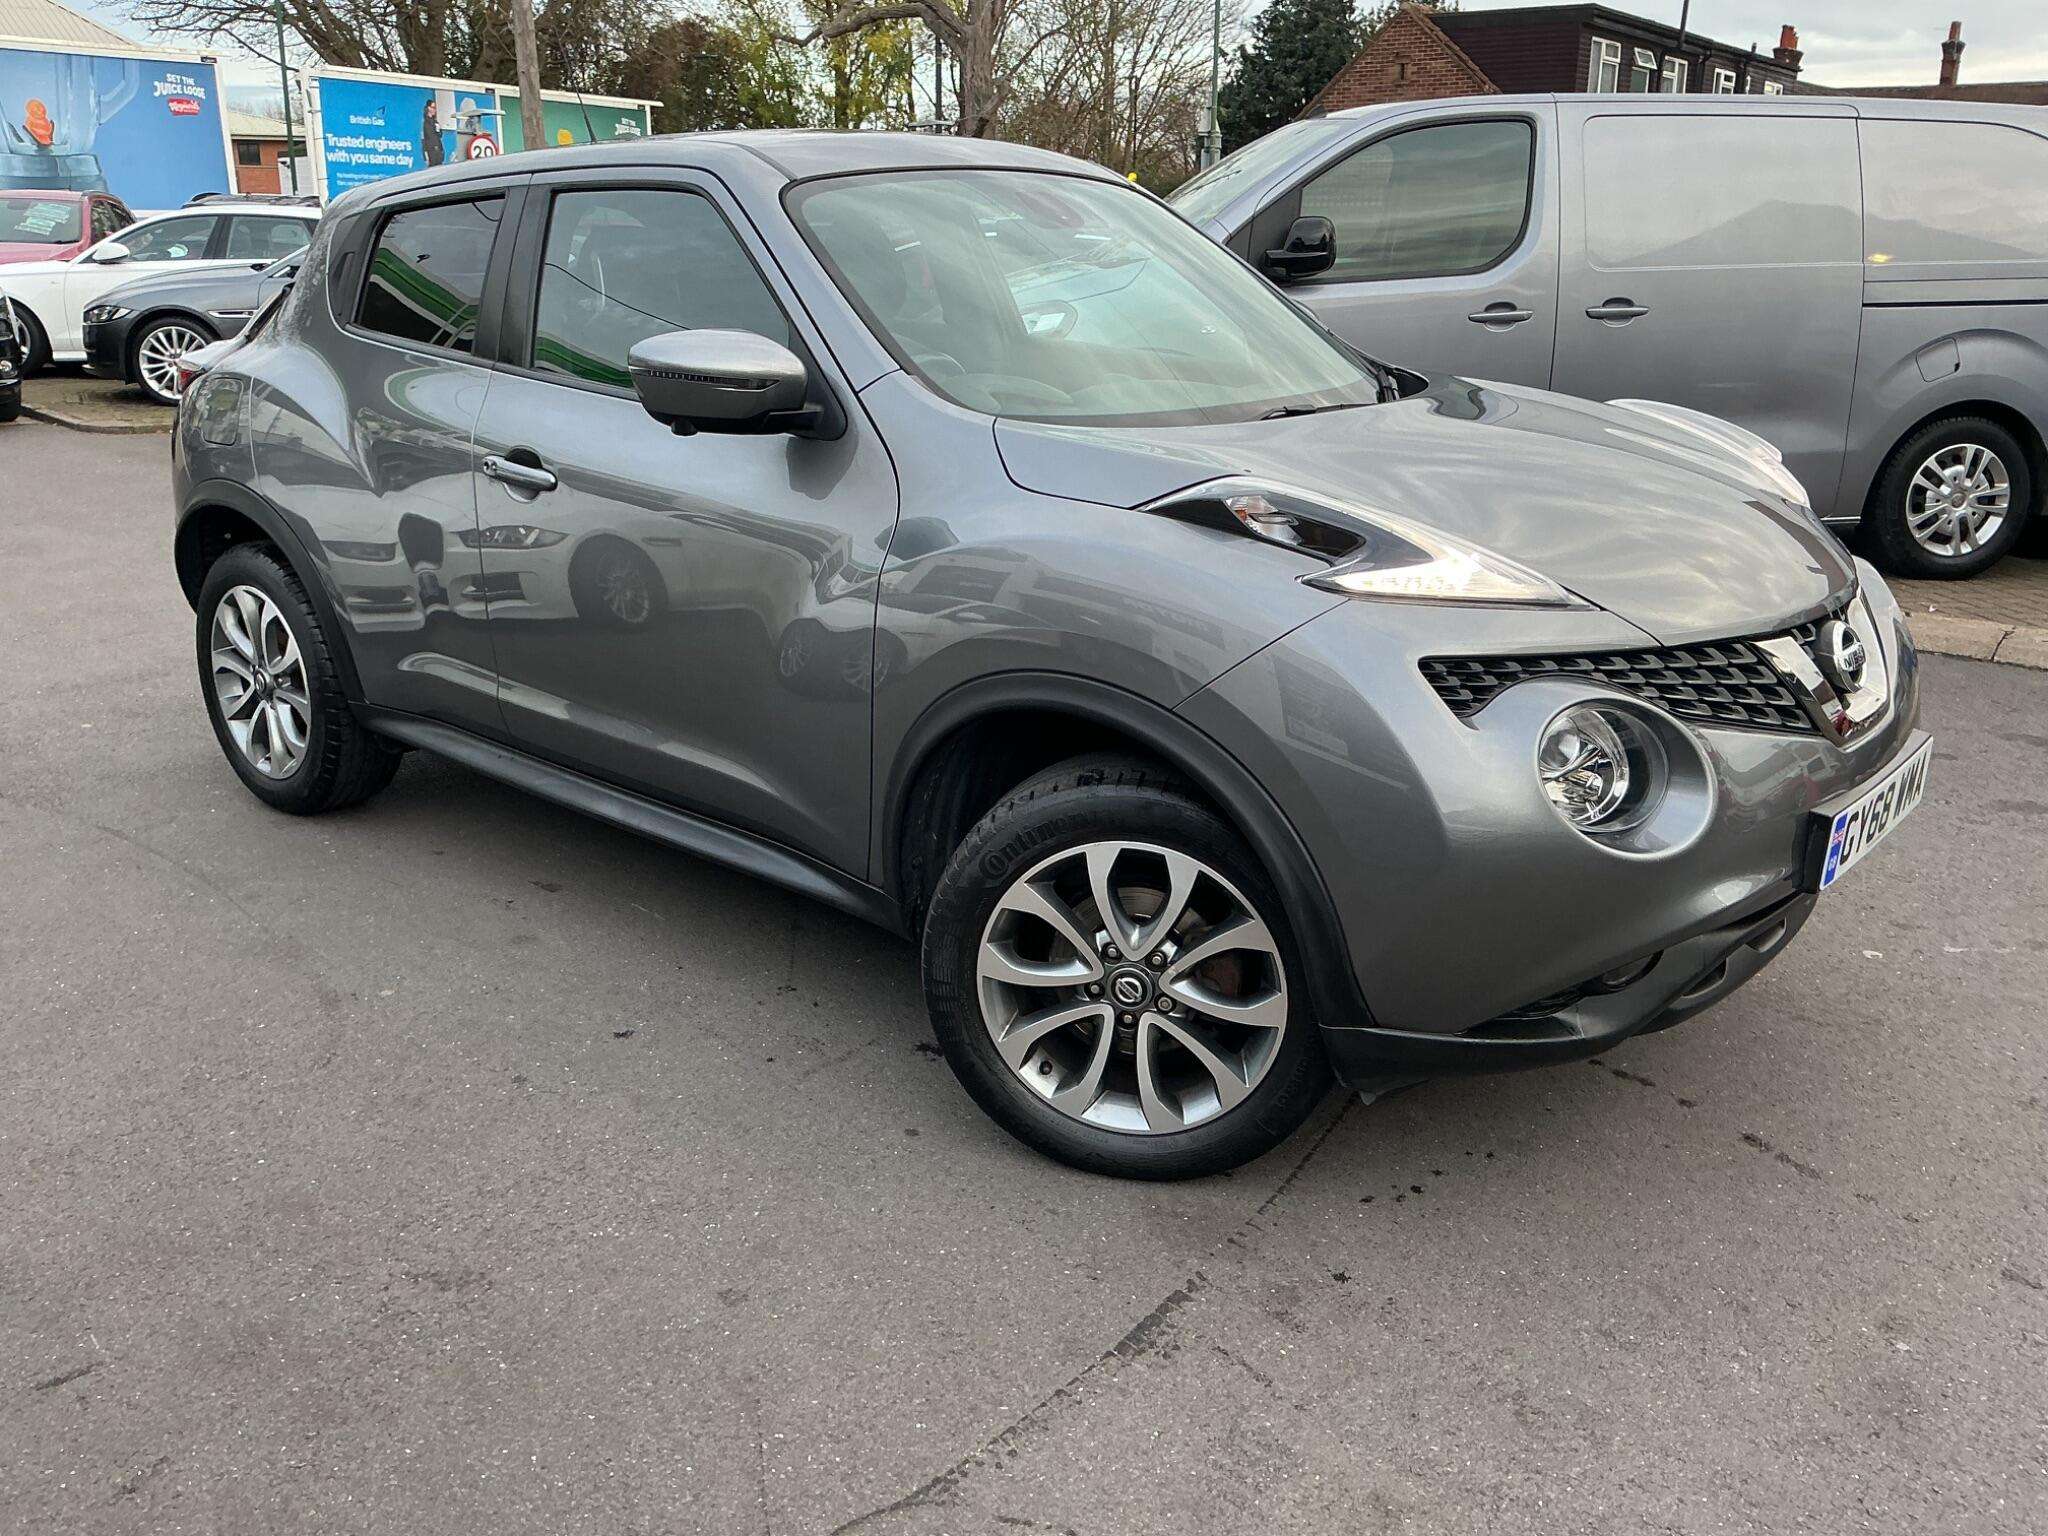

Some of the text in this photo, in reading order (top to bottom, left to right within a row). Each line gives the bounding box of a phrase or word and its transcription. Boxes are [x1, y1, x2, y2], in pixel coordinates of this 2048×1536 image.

[166, 73, 195, 86] SET THE
[153, 81, 182, 97] JUICE
[349, 115, 385, 126] British Gas
[326, 134, 412, 152] Trusted engineers
[327, 150, 413, 168] with you same day
[473, 145, 494, 158] 20
[1839, 781, 1896, 866] GY68
